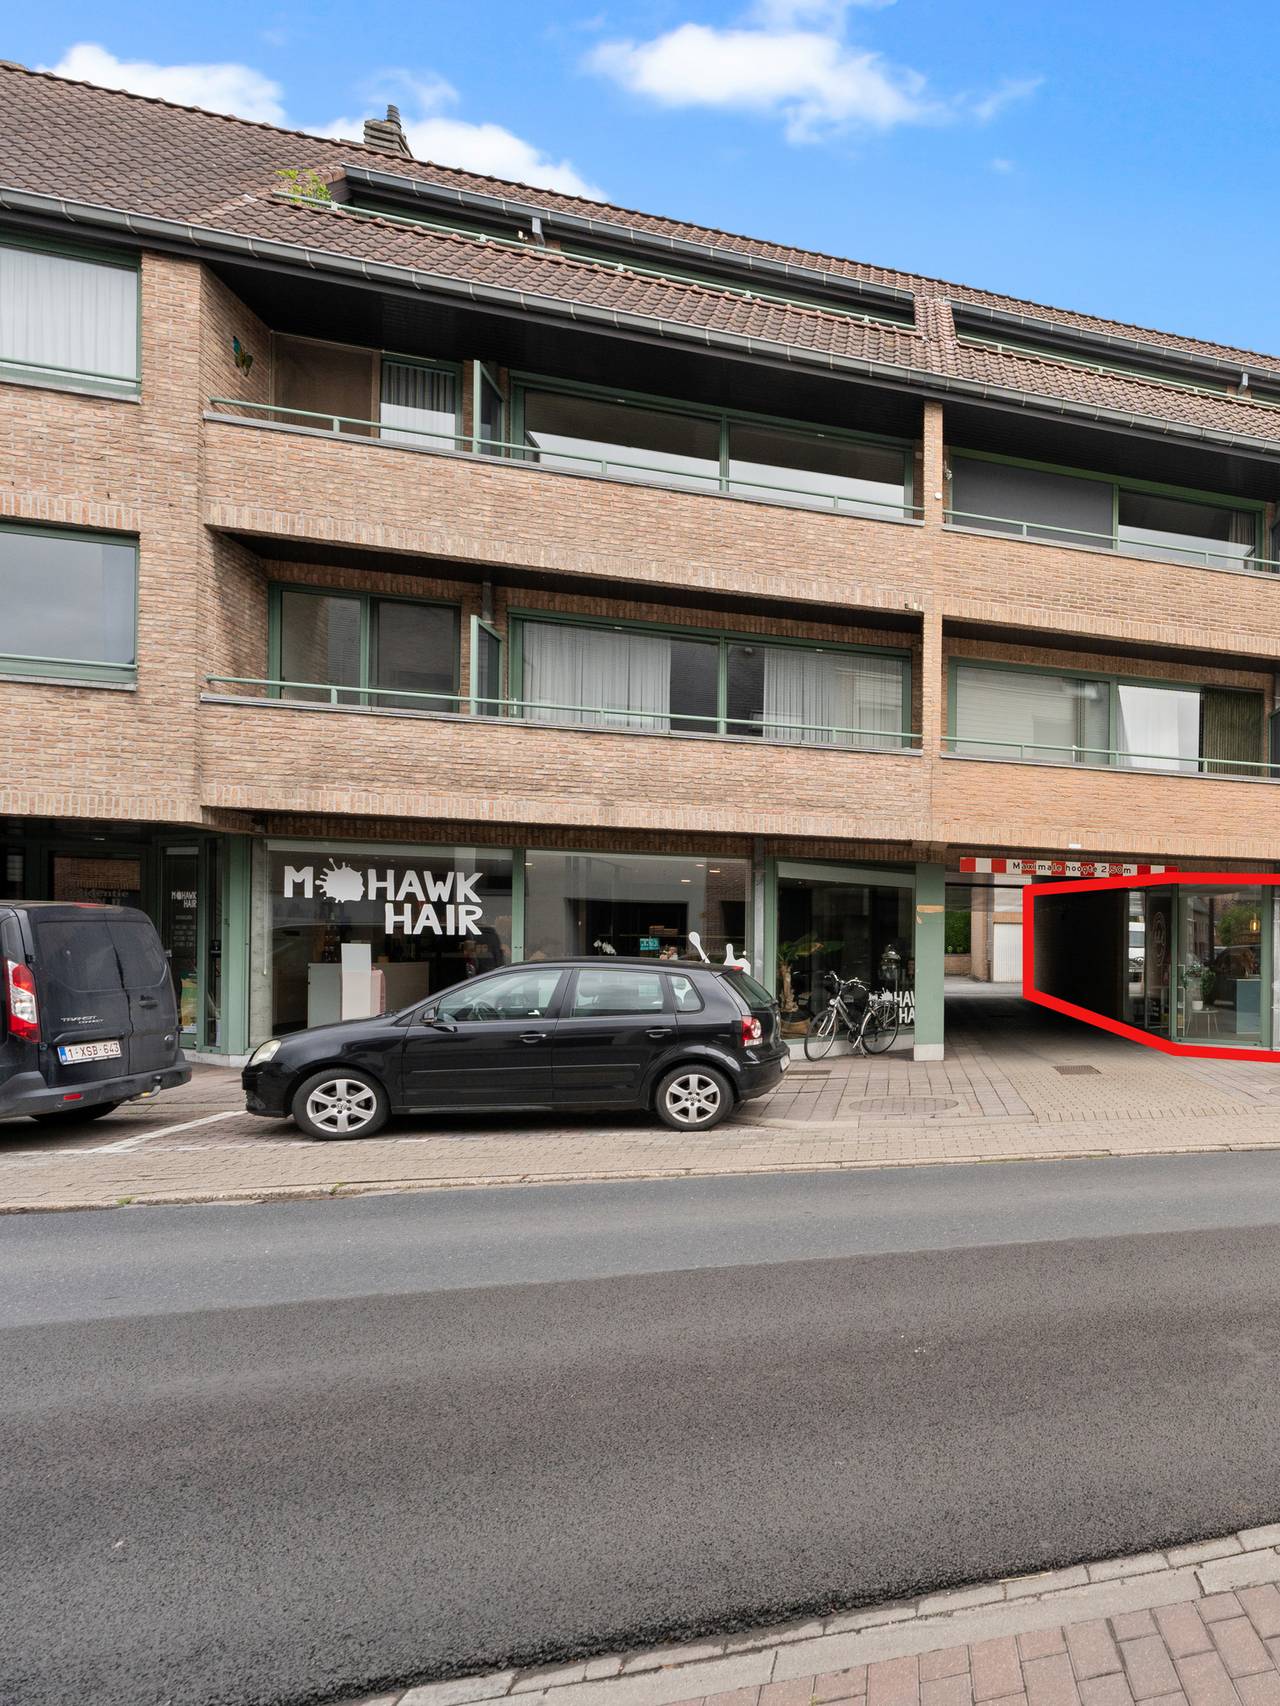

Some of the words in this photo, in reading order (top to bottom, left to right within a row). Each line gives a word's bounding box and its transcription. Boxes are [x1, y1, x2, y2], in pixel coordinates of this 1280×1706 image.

[1012, 862, 1062, 871] Maximale
[1066, 864, 1098, 875] hoogte
[385, 903, 483, 935] HAIR
[898, 1006, 914, 1023] HA
